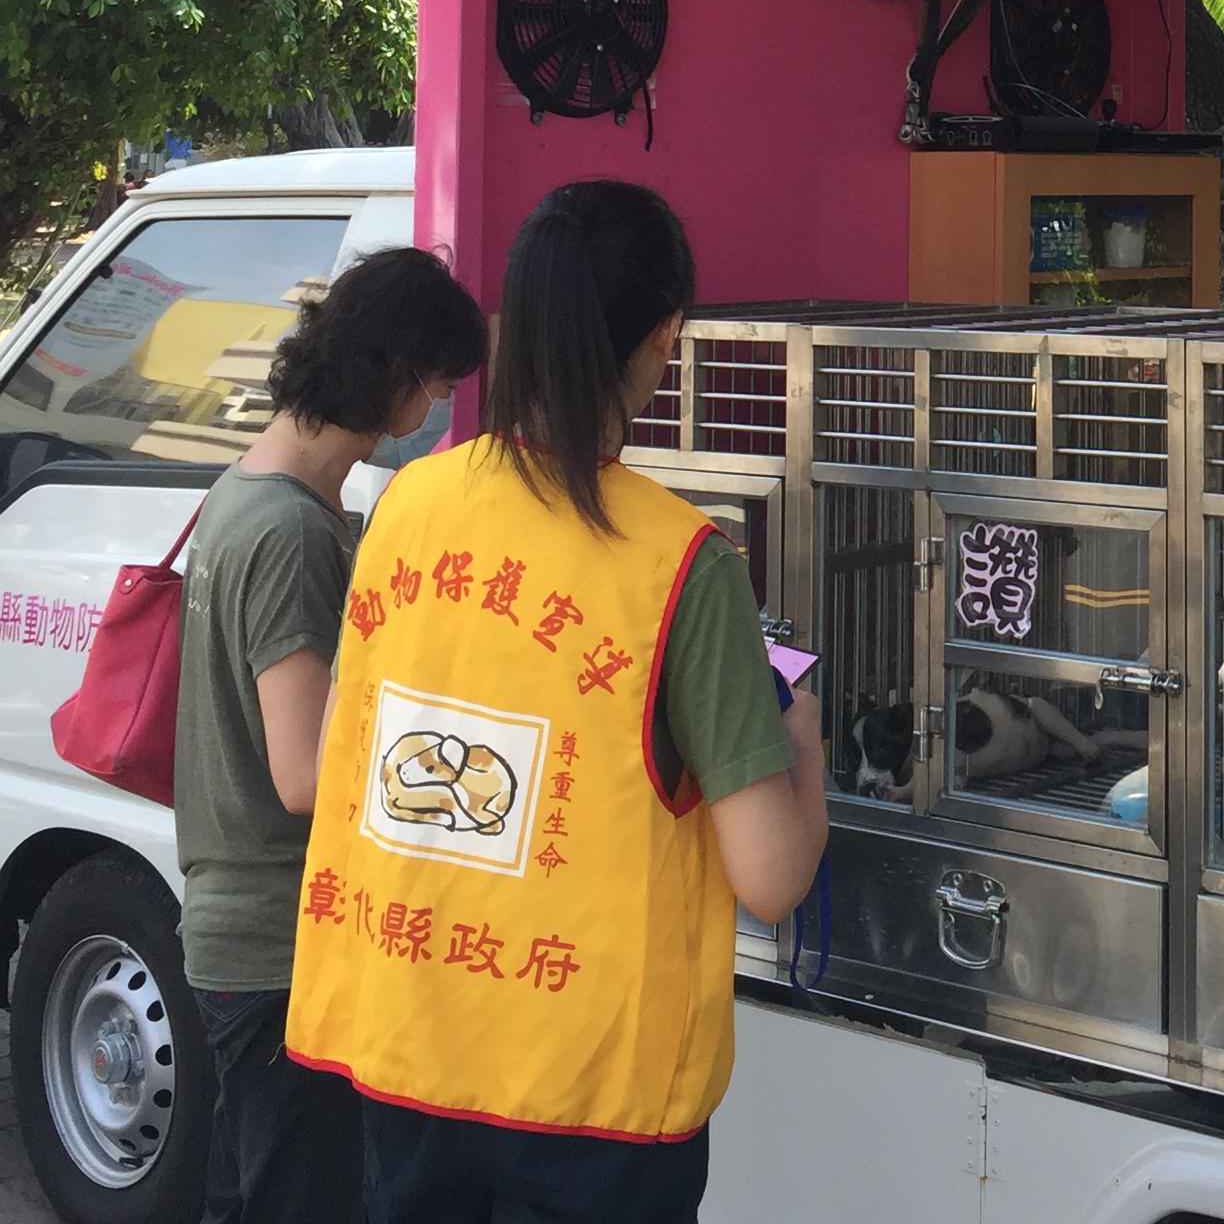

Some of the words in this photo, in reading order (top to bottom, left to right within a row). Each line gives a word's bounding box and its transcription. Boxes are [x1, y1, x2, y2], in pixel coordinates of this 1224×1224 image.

[348, 549, 634, 695] 動物保護宣導
[533, 731, 580, 879] 尊重生命
[303, 867, 581, 993] 彰化縣政府
